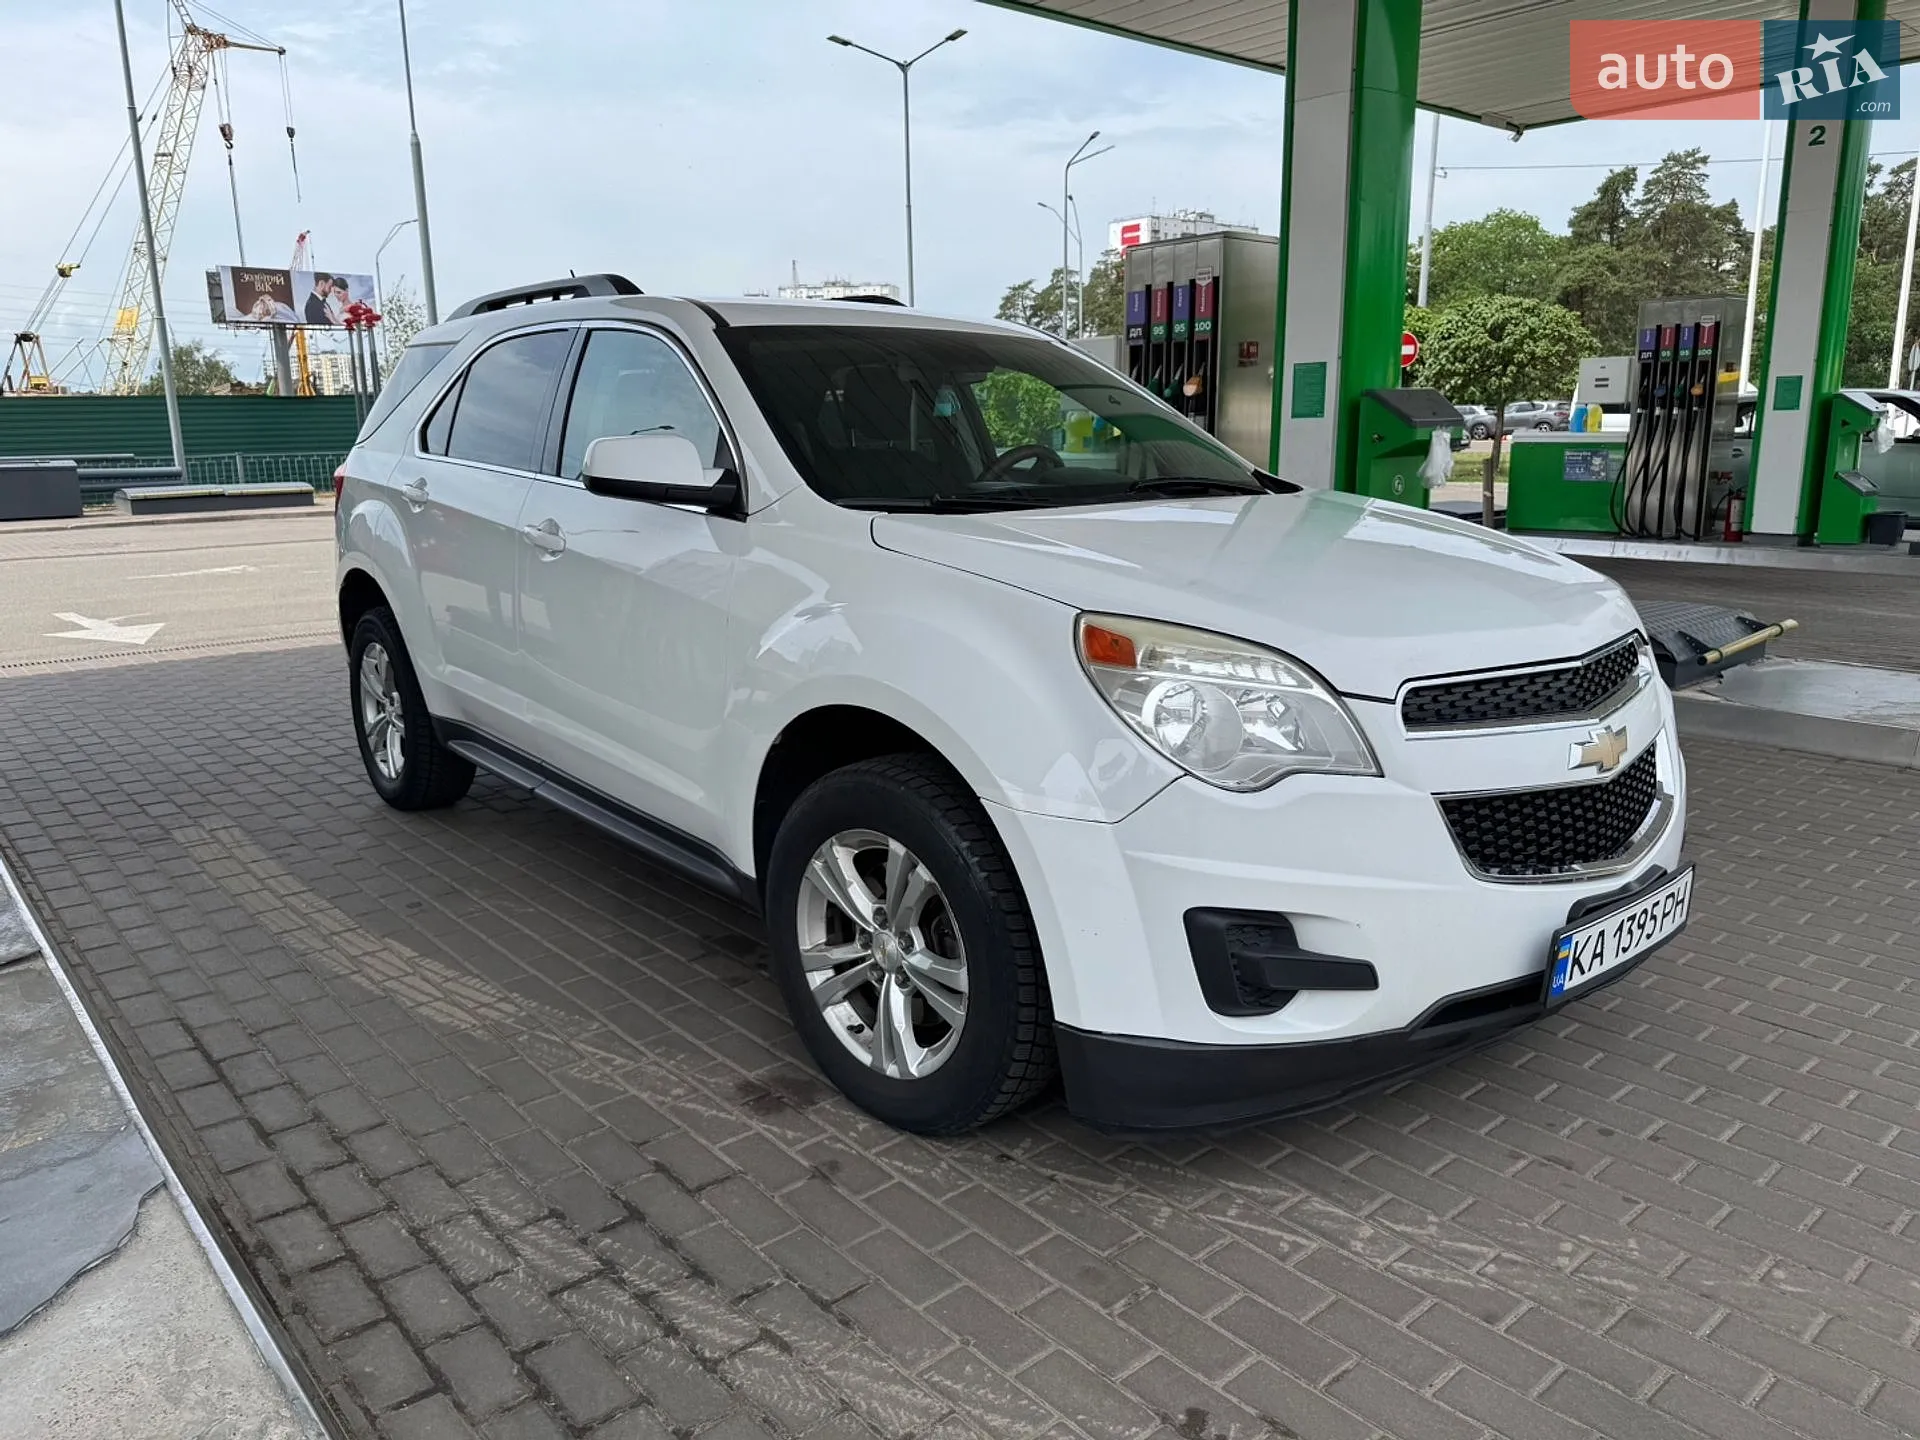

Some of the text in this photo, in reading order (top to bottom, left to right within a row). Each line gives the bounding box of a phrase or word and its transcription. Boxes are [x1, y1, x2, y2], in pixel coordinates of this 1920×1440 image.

[1808, 125, 1826, 146] 2
[1153, 326, 1165, 335] 95
[1174, 323, 1186, 333] 95
[1195, 321, 1212, 332] 100
[1129, 328, 1143, 338] ДП
